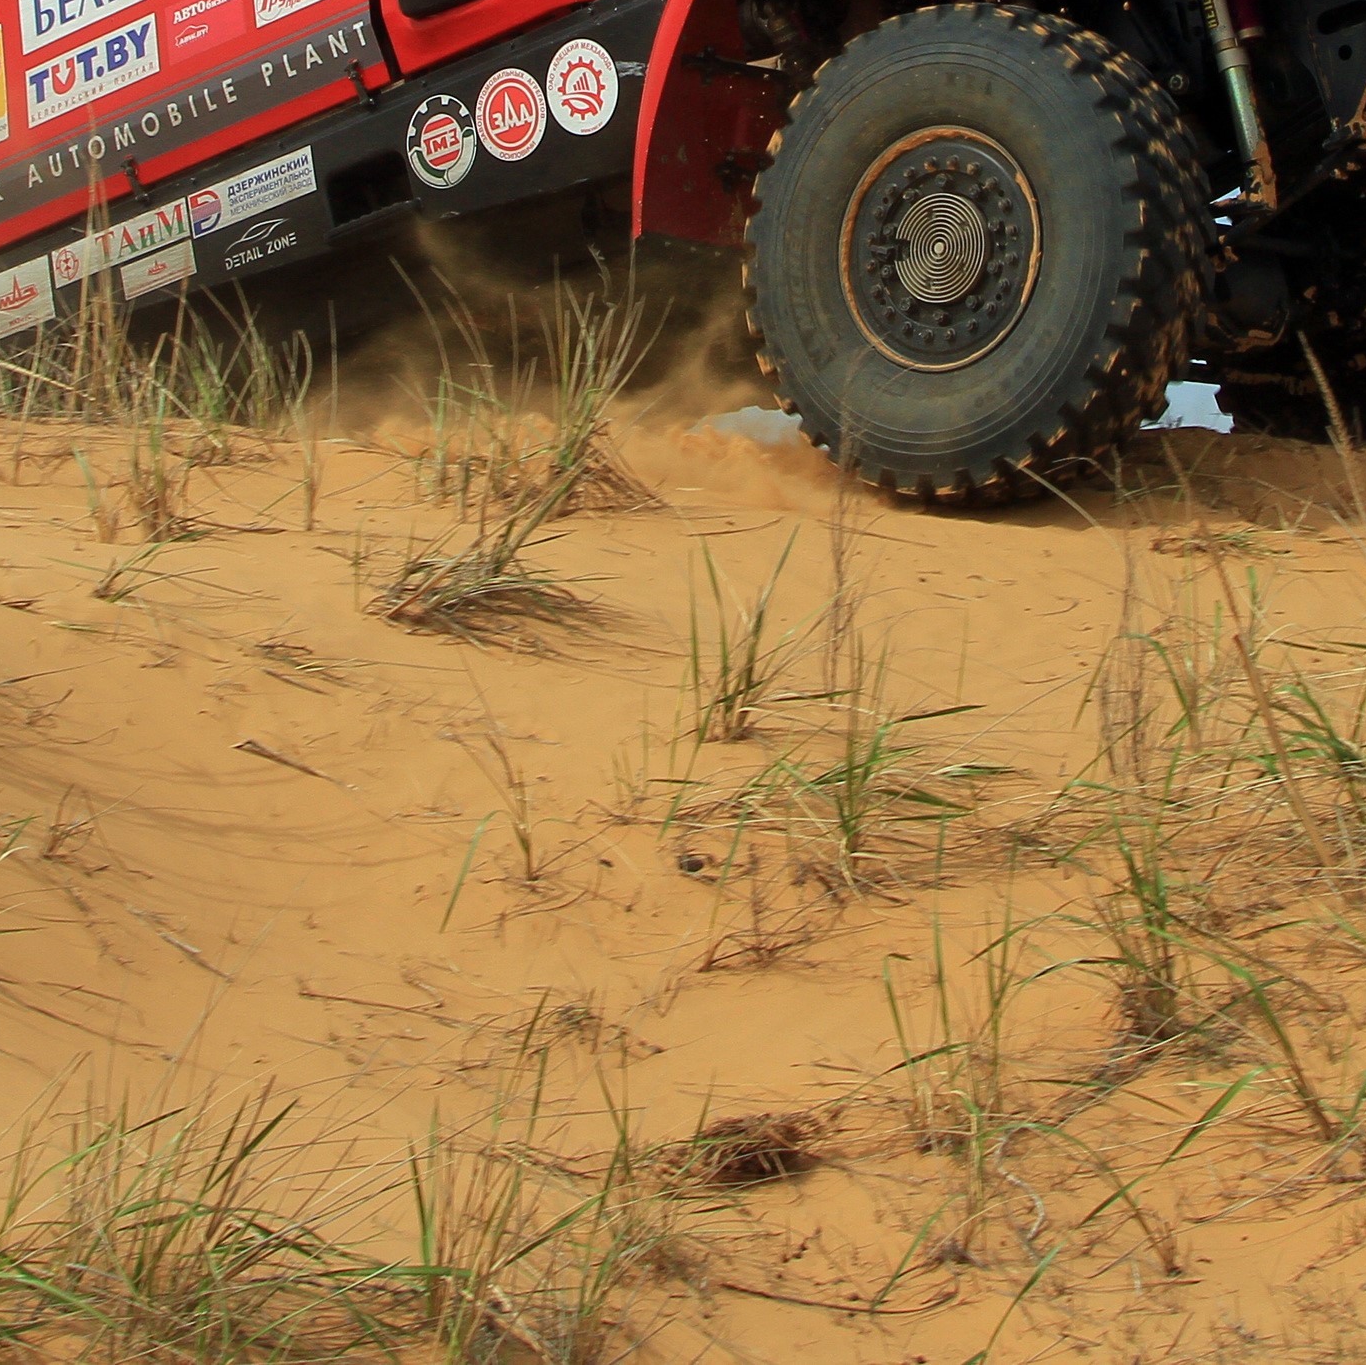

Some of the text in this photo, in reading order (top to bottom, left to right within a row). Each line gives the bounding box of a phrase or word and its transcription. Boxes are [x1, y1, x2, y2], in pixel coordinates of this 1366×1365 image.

[29, 21, 152, 104] TUT.BY
[261, 20, 366, 86] PLANT
[31, 60, 155, 123] БЕЛОРУССКИЙ ПОРТАЛ
[28, 78, 238, 189] AUTOMOBILE
[227, 154, 310, 198] ДЗЕРЖИНСКИЙ
[288, 177, 313, 197] ЗАВОД
[225, 231, 297, 272] DETAIL ZONE
